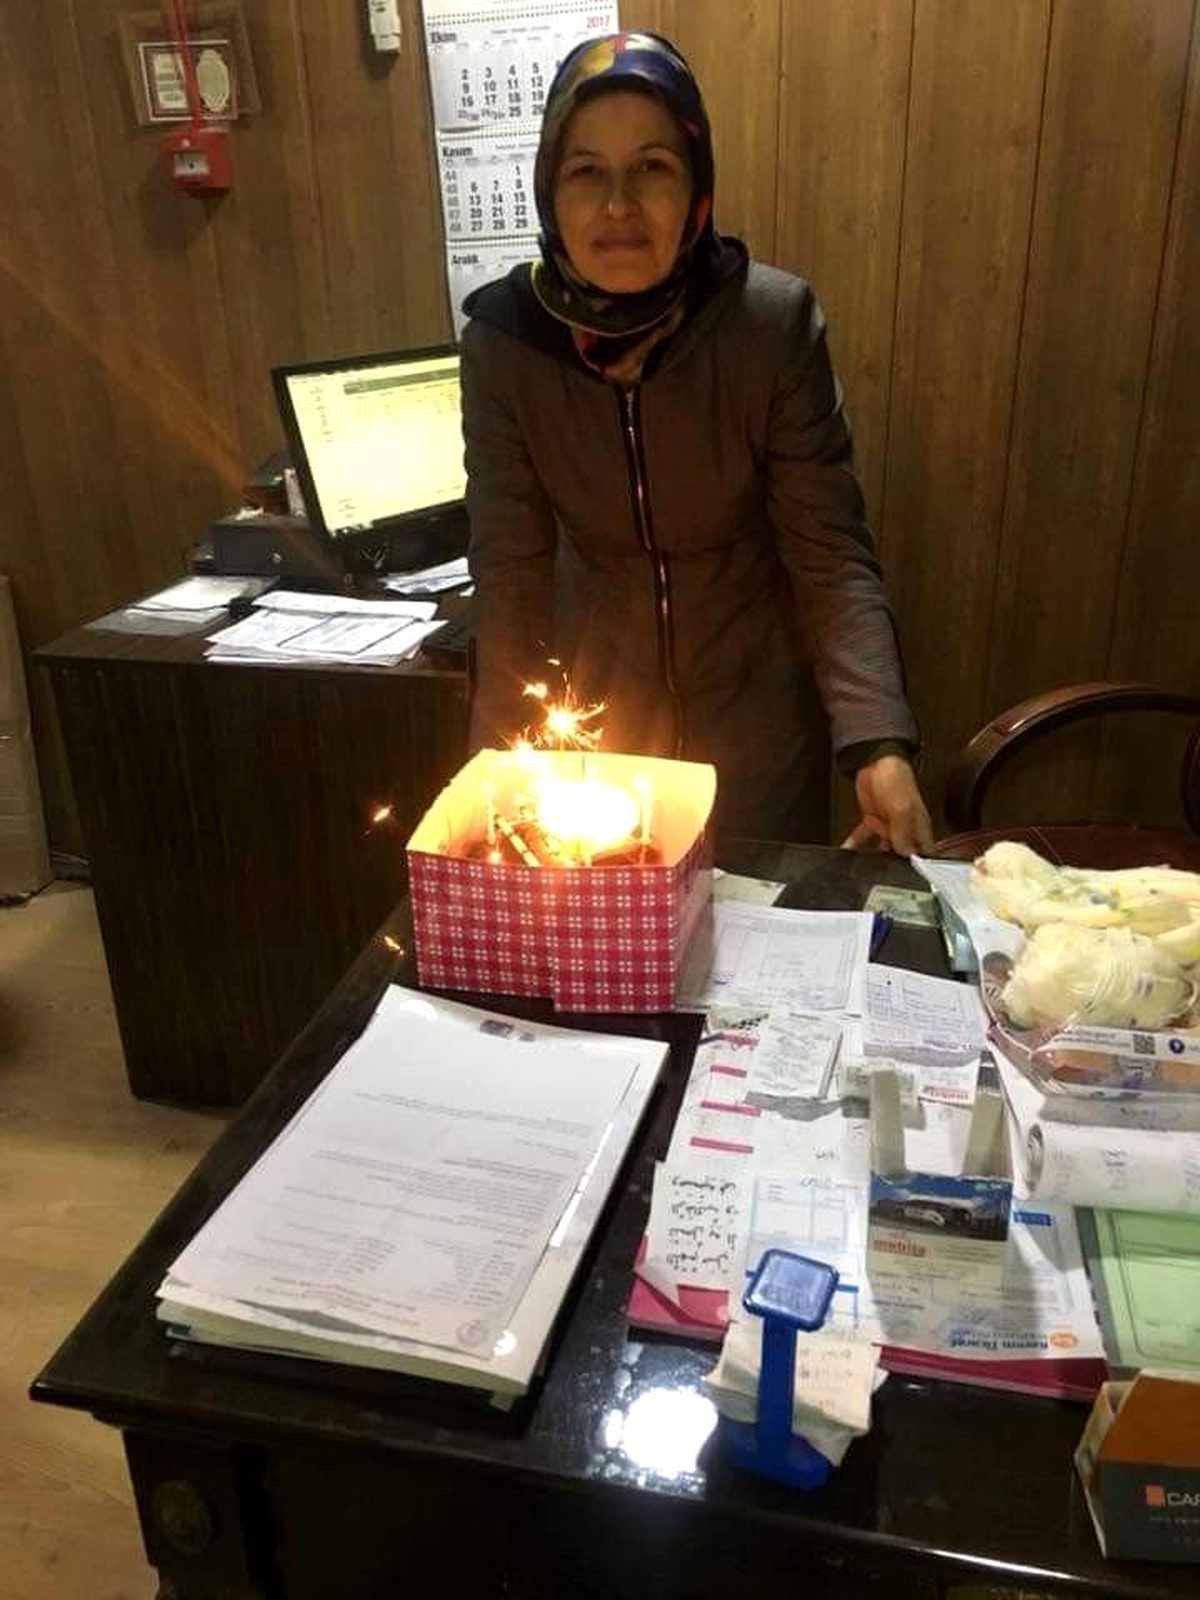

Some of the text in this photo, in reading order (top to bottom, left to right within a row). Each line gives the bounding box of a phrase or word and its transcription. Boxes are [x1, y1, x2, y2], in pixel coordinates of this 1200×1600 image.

[586, 15, 610, 28] 2017
[430, 32, 456, 44] Ekim
[461, 62, 539, 80] 2 3 4 5
[462, 77, 543, 94] 9 10 11 12
[485, 94, 496, 105] 17
[532, 90, 544, 101] 19
[509, 106, 521, 117] 25
[493, 180, 499, 191] 7
[469, 195, 481, 206] 13
[492, 193, 503, 204] 14
[514, 191, 526, 202] 15
[470, 207, 482, 219] 20
[492, 206, 503, 218] 21
[514, 204, 527, 216] 22
[471, 220, 482, 232] 27
